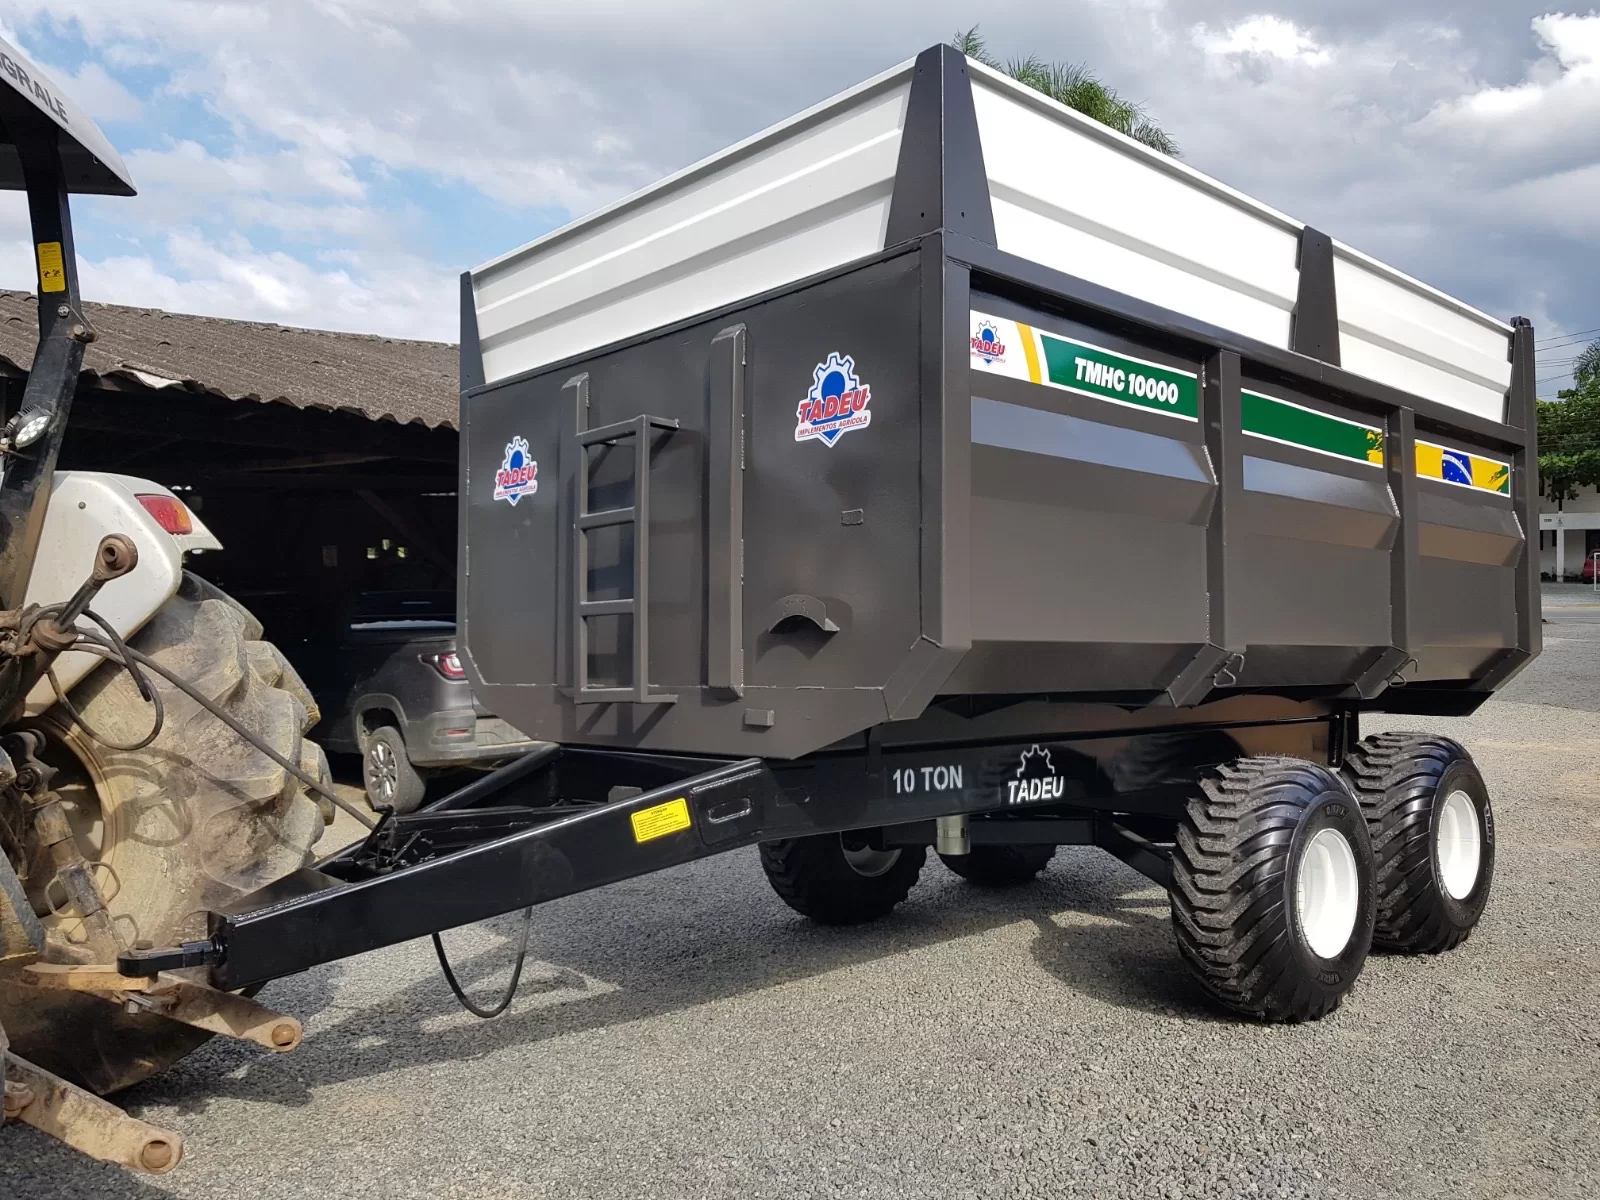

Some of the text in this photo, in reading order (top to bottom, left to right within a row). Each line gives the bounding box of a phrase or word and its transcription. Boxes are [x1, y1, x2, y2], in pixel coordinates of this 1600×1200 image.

[0, 52, 69, 124] GRALE
[970, 337, 1006, 355] TADEU
[1075, 357, 1179, 405] TMHC 10000
[799, 387, 868, 424] TADEU
[797, 422, 837, 436] IMPLEMENTOS
[497, 464, 536, 487] TADEU
[892, 765, 963, 794] 10 TON
[1007, 775, 1064, 804] TADEU
